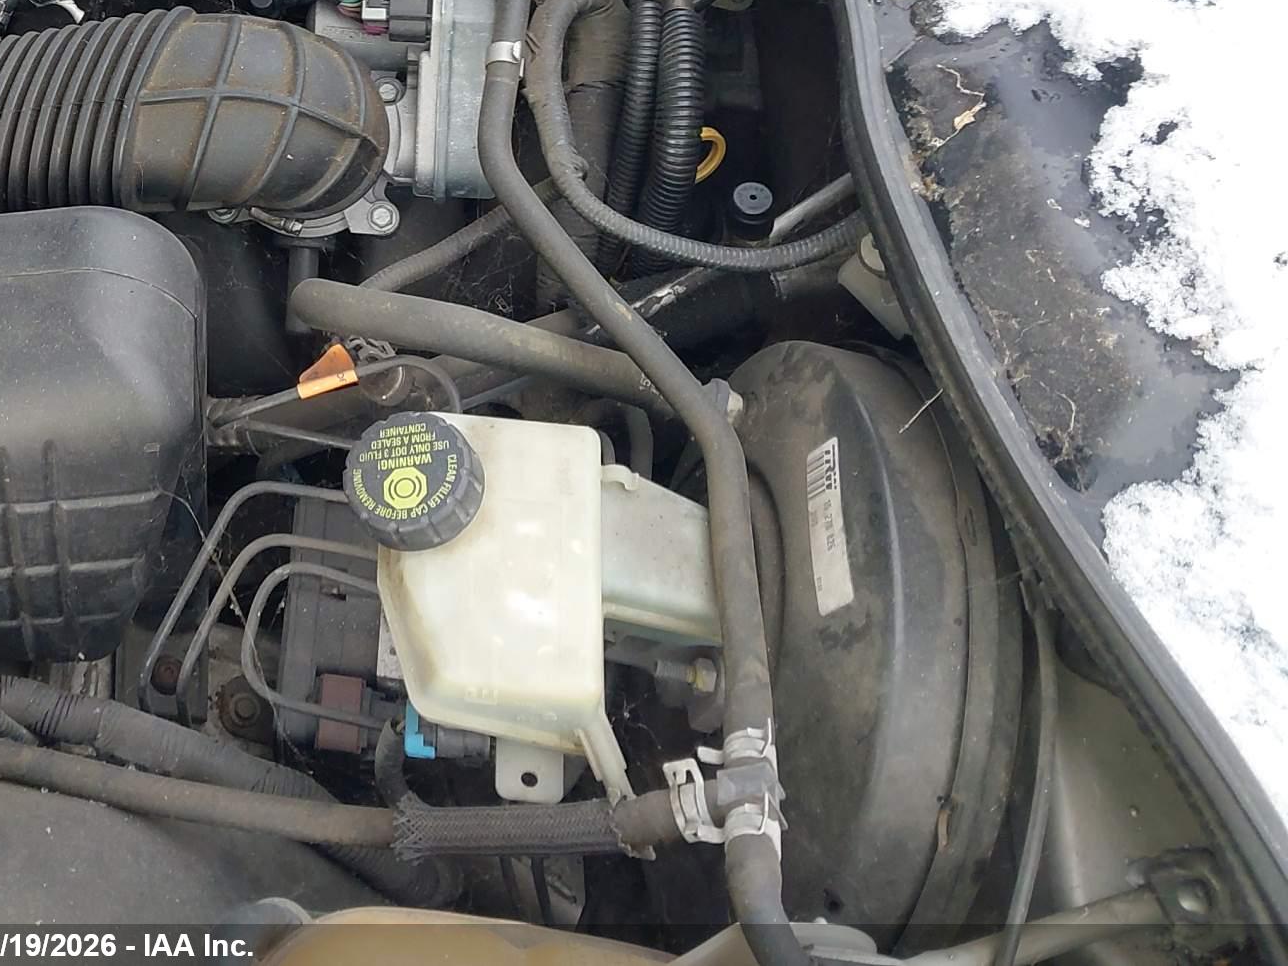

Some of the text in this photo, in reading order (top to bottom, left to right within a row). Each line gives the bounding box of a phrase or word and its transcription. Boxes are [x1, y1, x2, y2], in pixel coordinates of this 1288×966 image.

[379, 422, 427, 438] CONTAINER
[371, 431, 436, 450] FROM A SEALED
[359, 440, 450, 462] USE ONLY DOT 3 FLUID
[377, 453, 432, 470] WARNING!
[352, 454, 457, 520] CLEAN FILLER CAP BEFORE REMOVING
